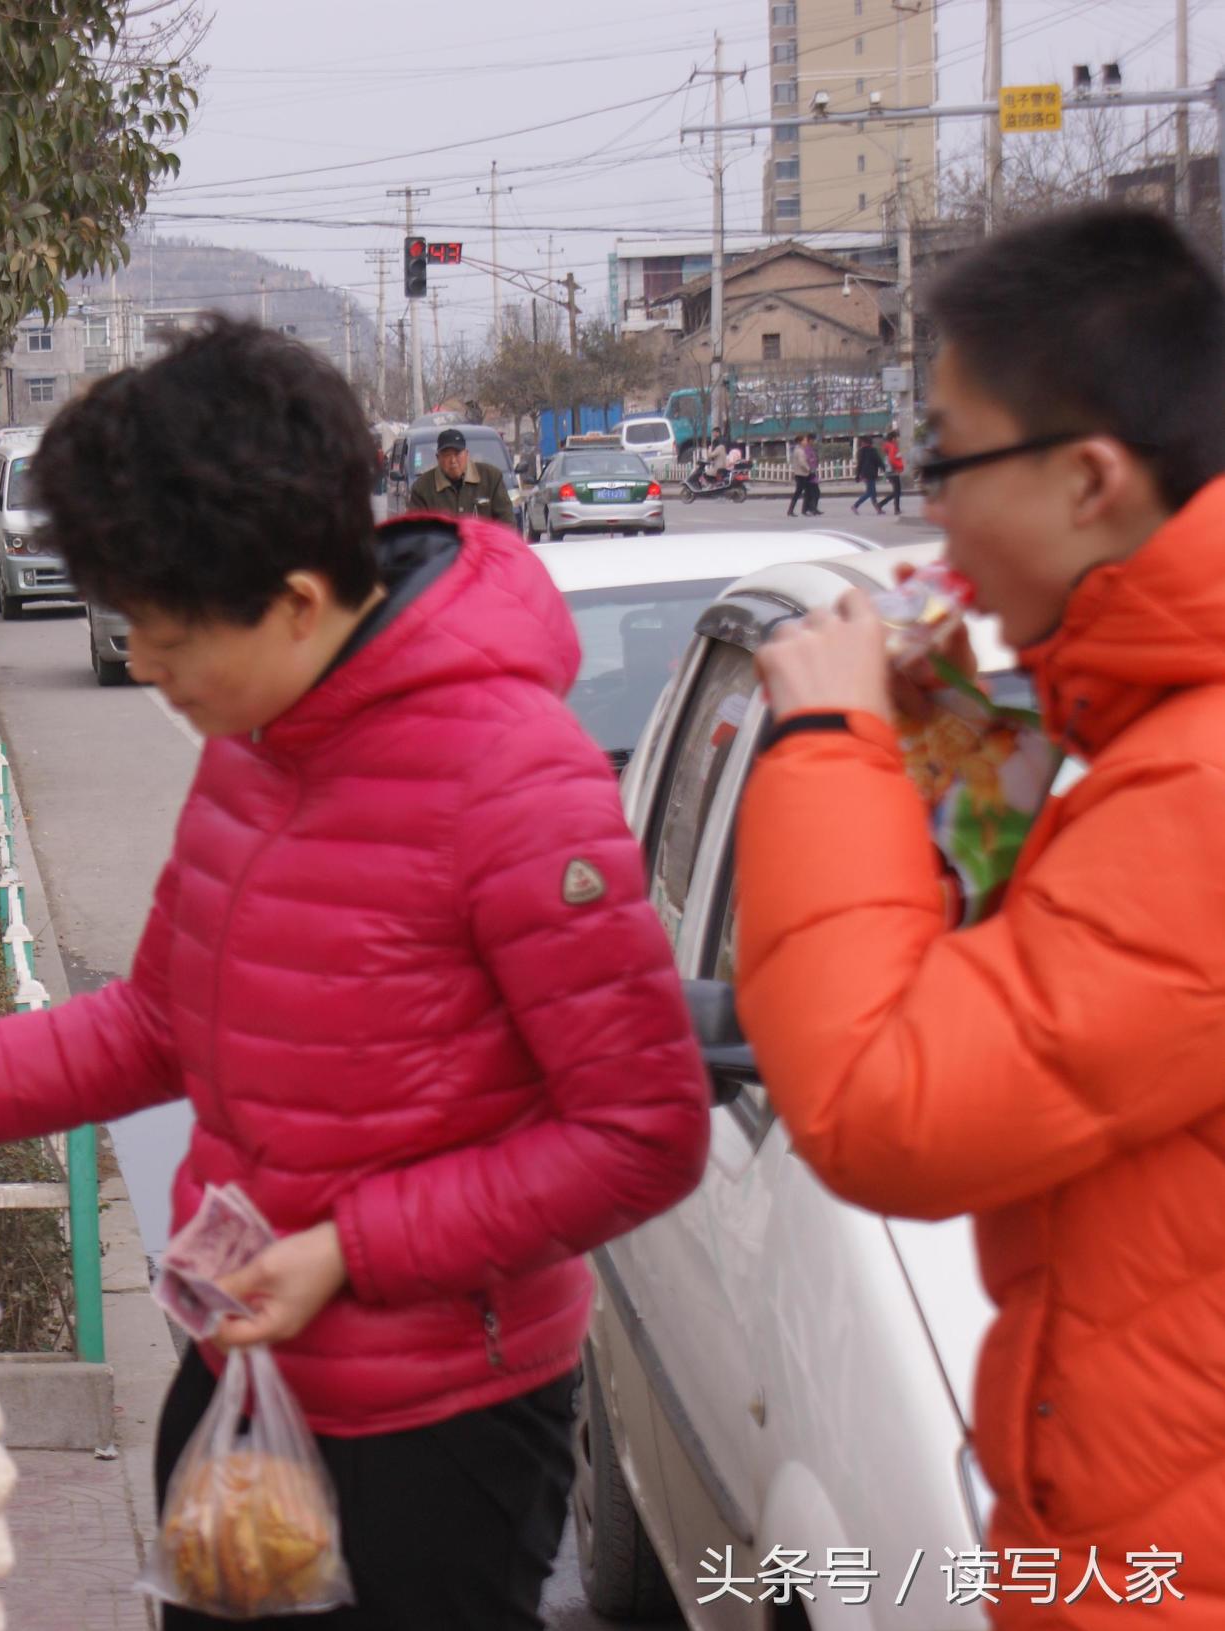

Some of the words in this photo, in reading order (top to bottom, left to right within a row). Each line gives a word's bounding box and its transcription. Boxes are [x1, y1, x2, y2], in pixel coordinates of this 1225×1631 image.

[1003, 91, 1057, 108] 电子警察
[1005, 111, 1057, 128] 监控路口
[429, 243, 460, 264] 43
